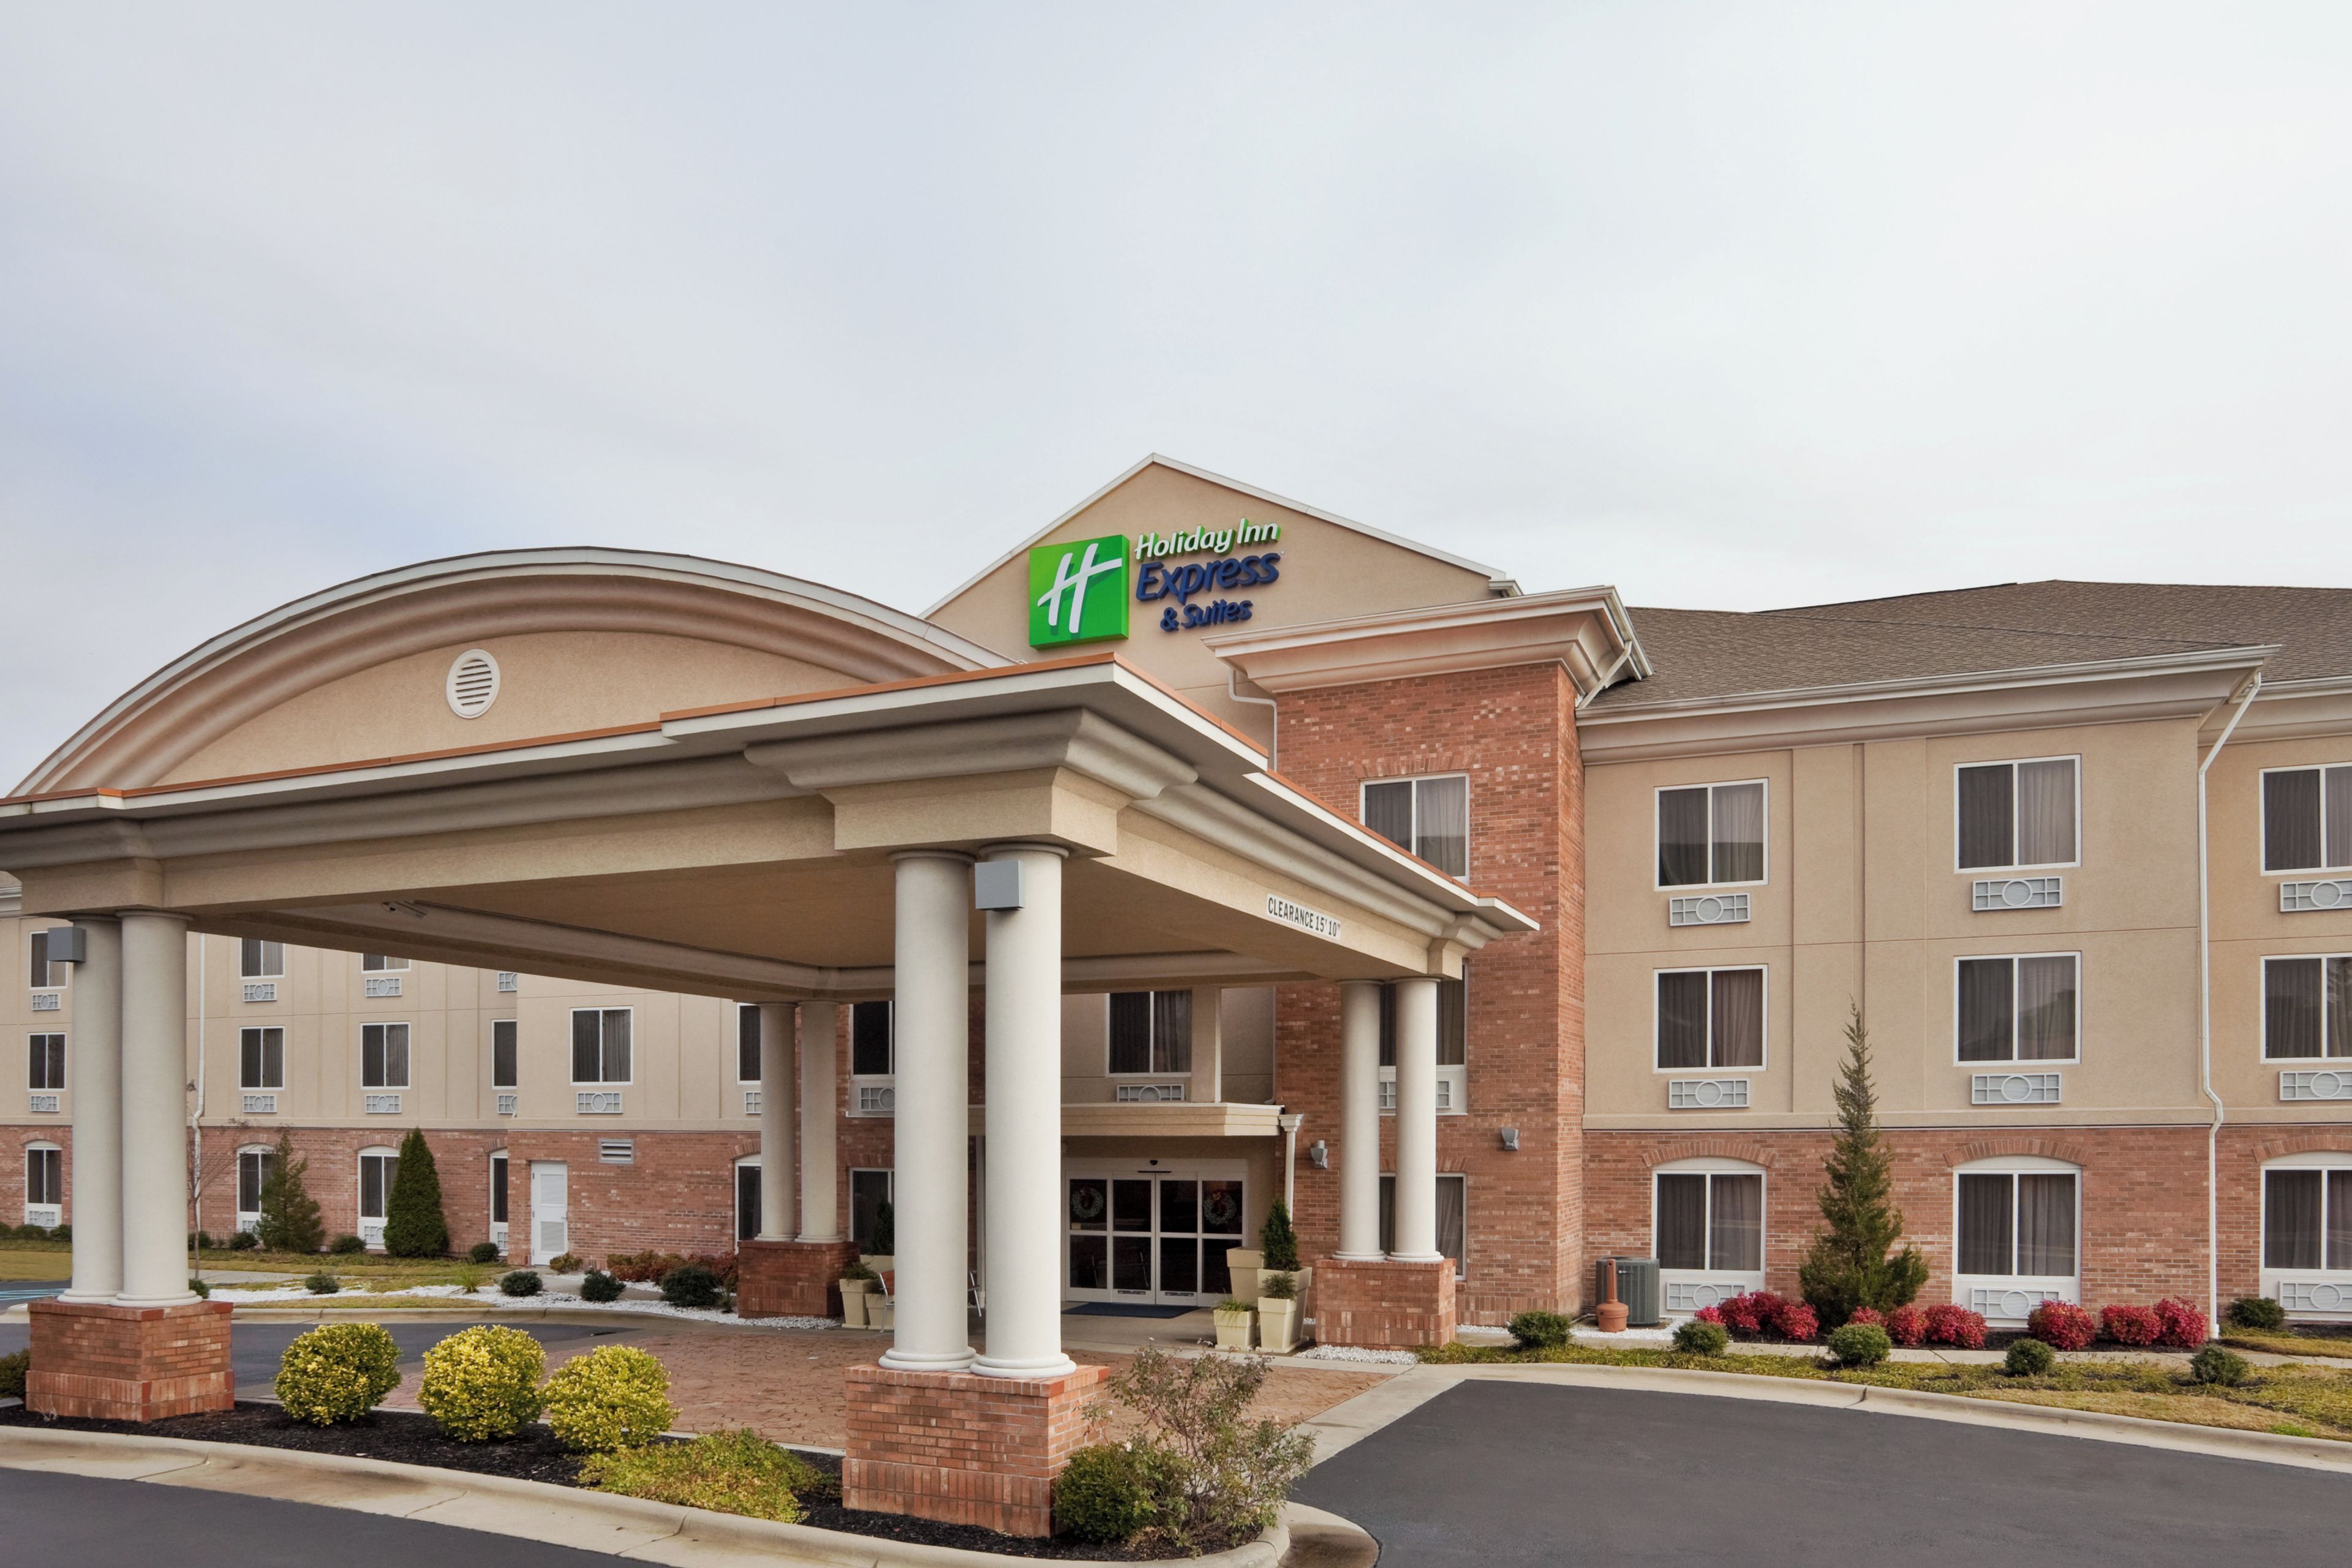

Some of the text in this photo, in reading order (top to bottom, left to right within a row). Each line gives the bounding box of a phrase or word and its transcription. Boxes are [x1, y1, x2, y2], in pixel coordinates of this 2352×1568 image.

[1134, 517, 1281, 562] Holiday Inn
[1136, 552, 1281, 605] Express
[1160, 598, 1253, 632] & Suites
[1268, 897, 1314, 929] CLEARANCE
